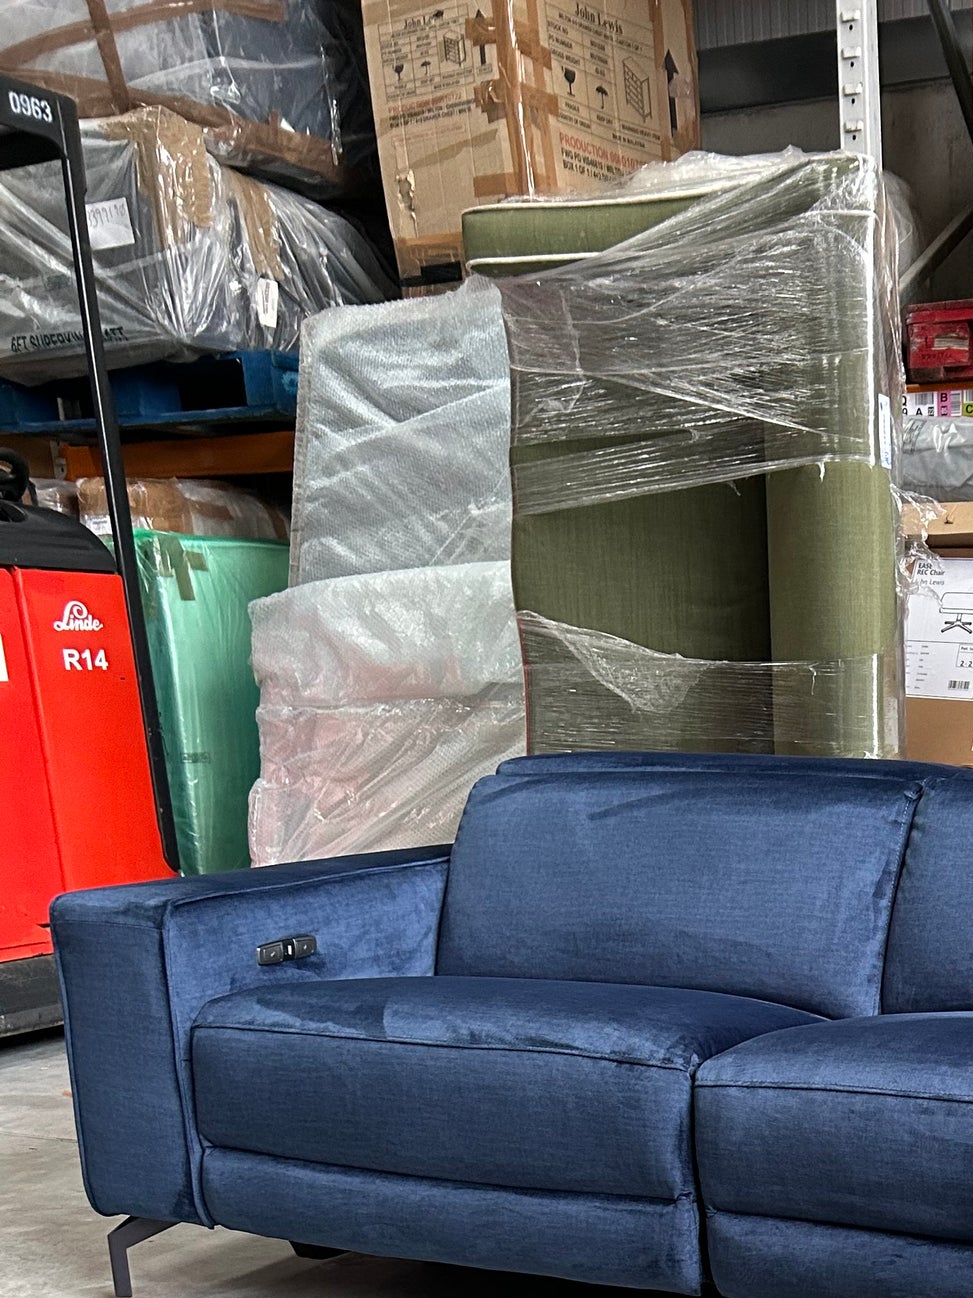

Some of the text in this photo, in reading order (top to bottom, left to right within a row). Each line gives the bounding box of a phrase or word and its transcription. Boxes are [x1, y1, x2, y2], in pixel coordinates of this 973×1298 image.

[575, 3, 596, 23] John
[597, 12, 623, 35] Lewis
[8, 90, 53, 123] 0963
[559, 131, 608, 162] PRODUCTION
[940, 392, 948, 402] B
[966, 404, 973, 414] C
[53, 600, 104, 631] Linde
[62, 648, 109, 671] R14
